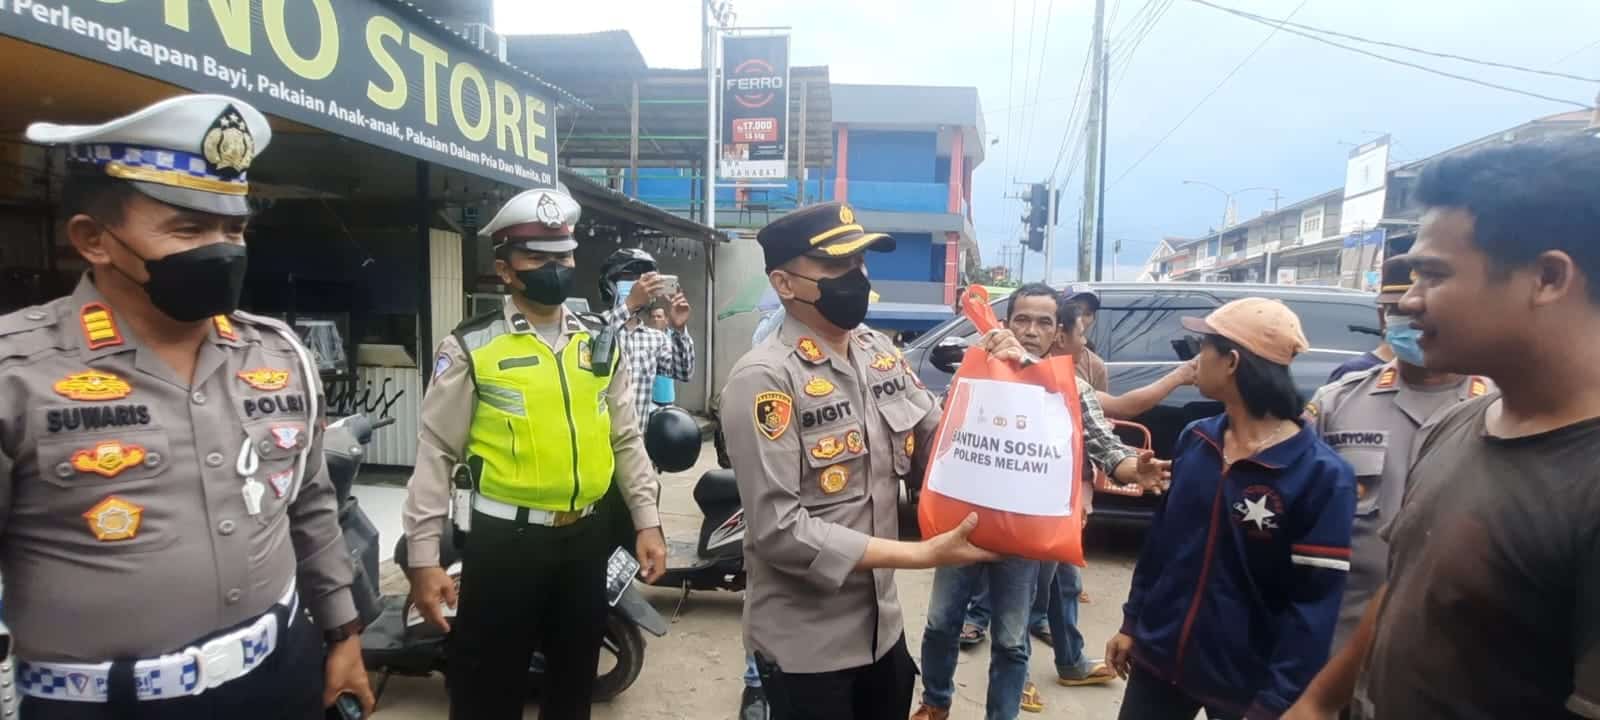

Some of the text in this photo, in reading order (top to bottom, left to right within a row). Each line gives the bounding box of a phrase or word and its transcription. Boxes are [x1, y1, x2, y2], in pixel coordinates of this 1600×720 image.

[13, 0, 199, 71] Perlengkapan
[203, 56, 253, 91] Bayi,
[257, 74, 325, 113] Pakaian
[328, 101, 404, 141] Anak-anak,
[406, 127, 449, 154] Pakaian
[449, 142, 480, 164] Dalam
[480, 153, 498, 169] Pria
[499, 158, 514, 174] Dan
[365, 15, 549, 166] STORE
[727, 76, 783, 90] FERRO
[743, 121, 773, 130] 17.000
[46, 404, 151, 432] SUWARIS
[244, 394, 305, 417] POLRI
[801, 401, 852, 428] SIGIT
[952, 430, 1062, 459] BANTUAN SOSIAL
[953, 447, 1049, 474] POLRES MELAWI
